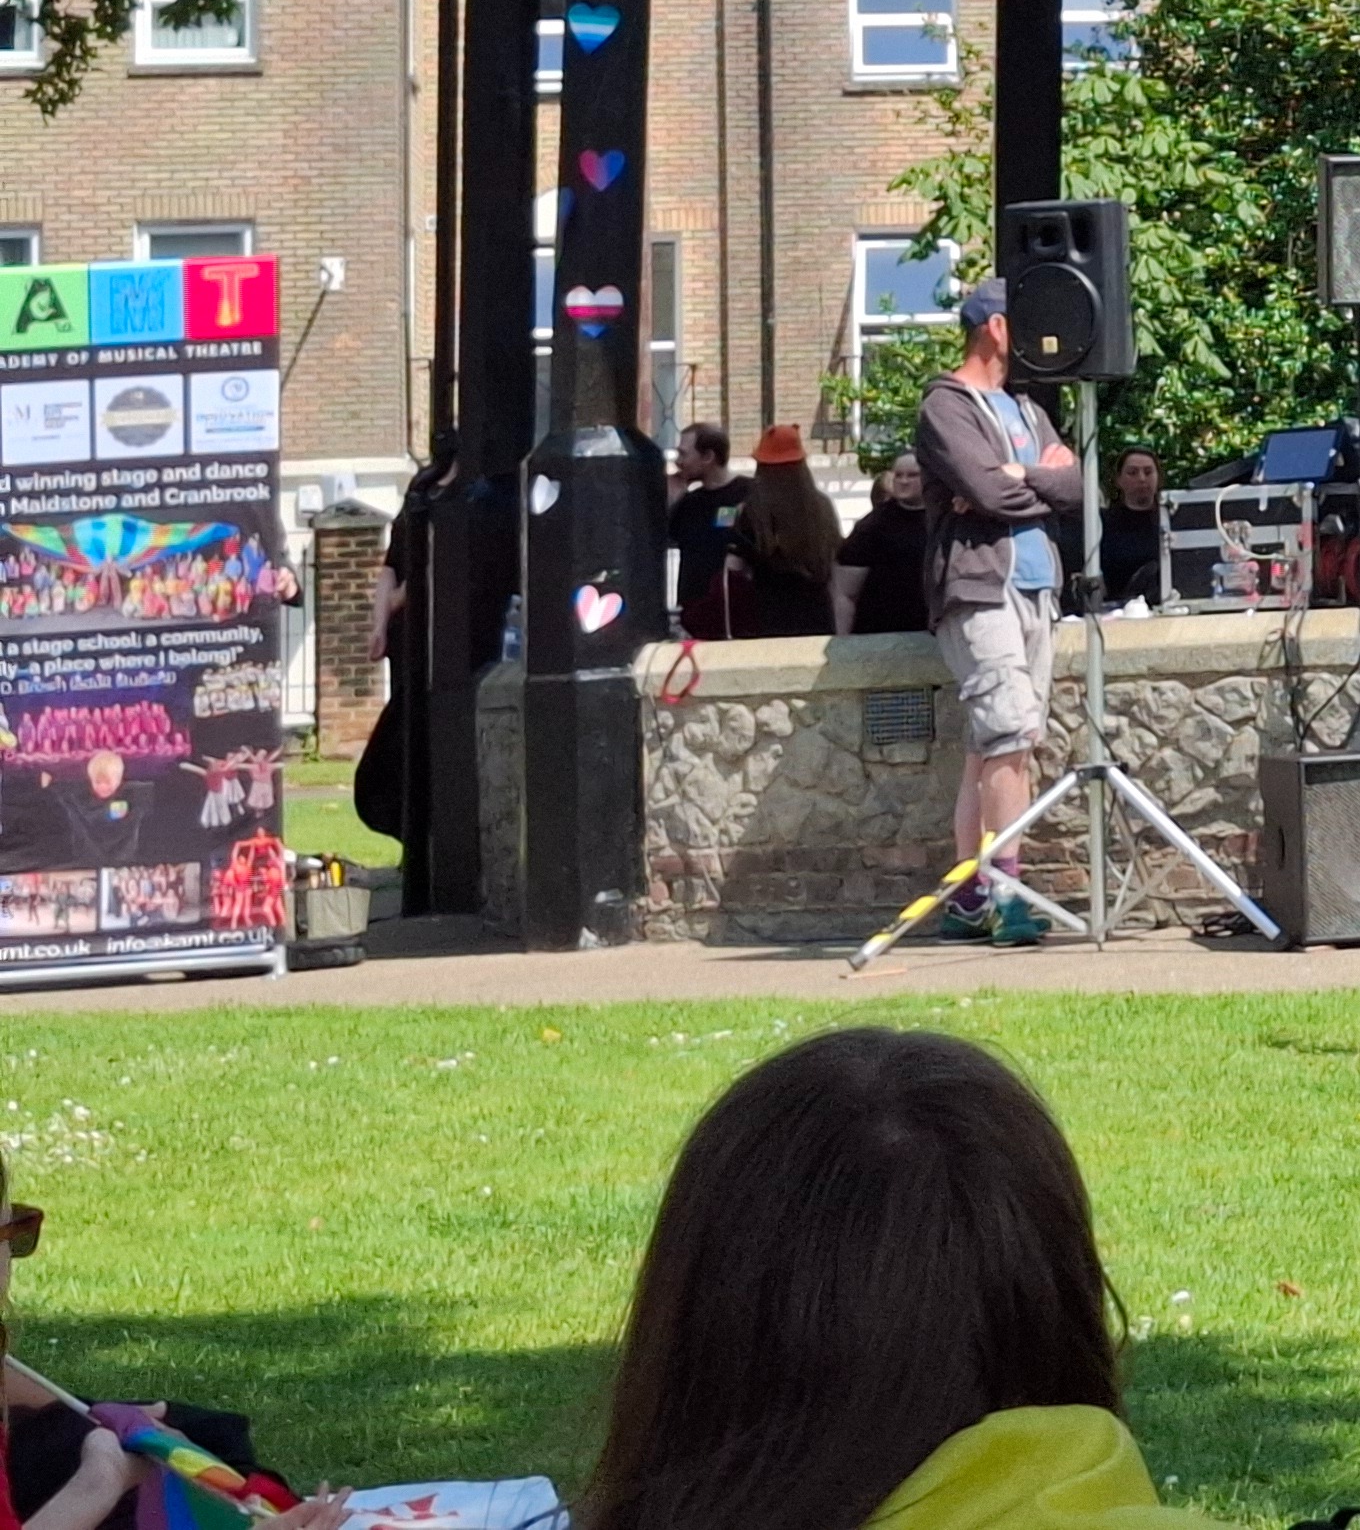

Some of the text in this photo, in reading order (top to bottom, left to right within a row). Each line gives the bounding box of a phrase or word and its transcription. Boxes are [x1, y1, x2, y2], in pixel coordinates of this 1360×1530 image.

[66, 351, 90, 366] OF
[97, 344, 178, 364] MUSICAL
[184, 341, 262, 359] THEATRE
[15, 470, 97, 492] winning
[101, 468, 158, 489] stage
[162, 462, 201, 482] and
[205, 461, 268, 480] dance
[11, 493, 117, 515] Maidstone
[121, 488, 160, 508] and
[165, 483, 270, 504] Cranbrook
[23, 637, 73, 656] stage
[146, 634, 157, 647] a
[44, 654, 95, 677] place
[99, 651, 155, 670] where
